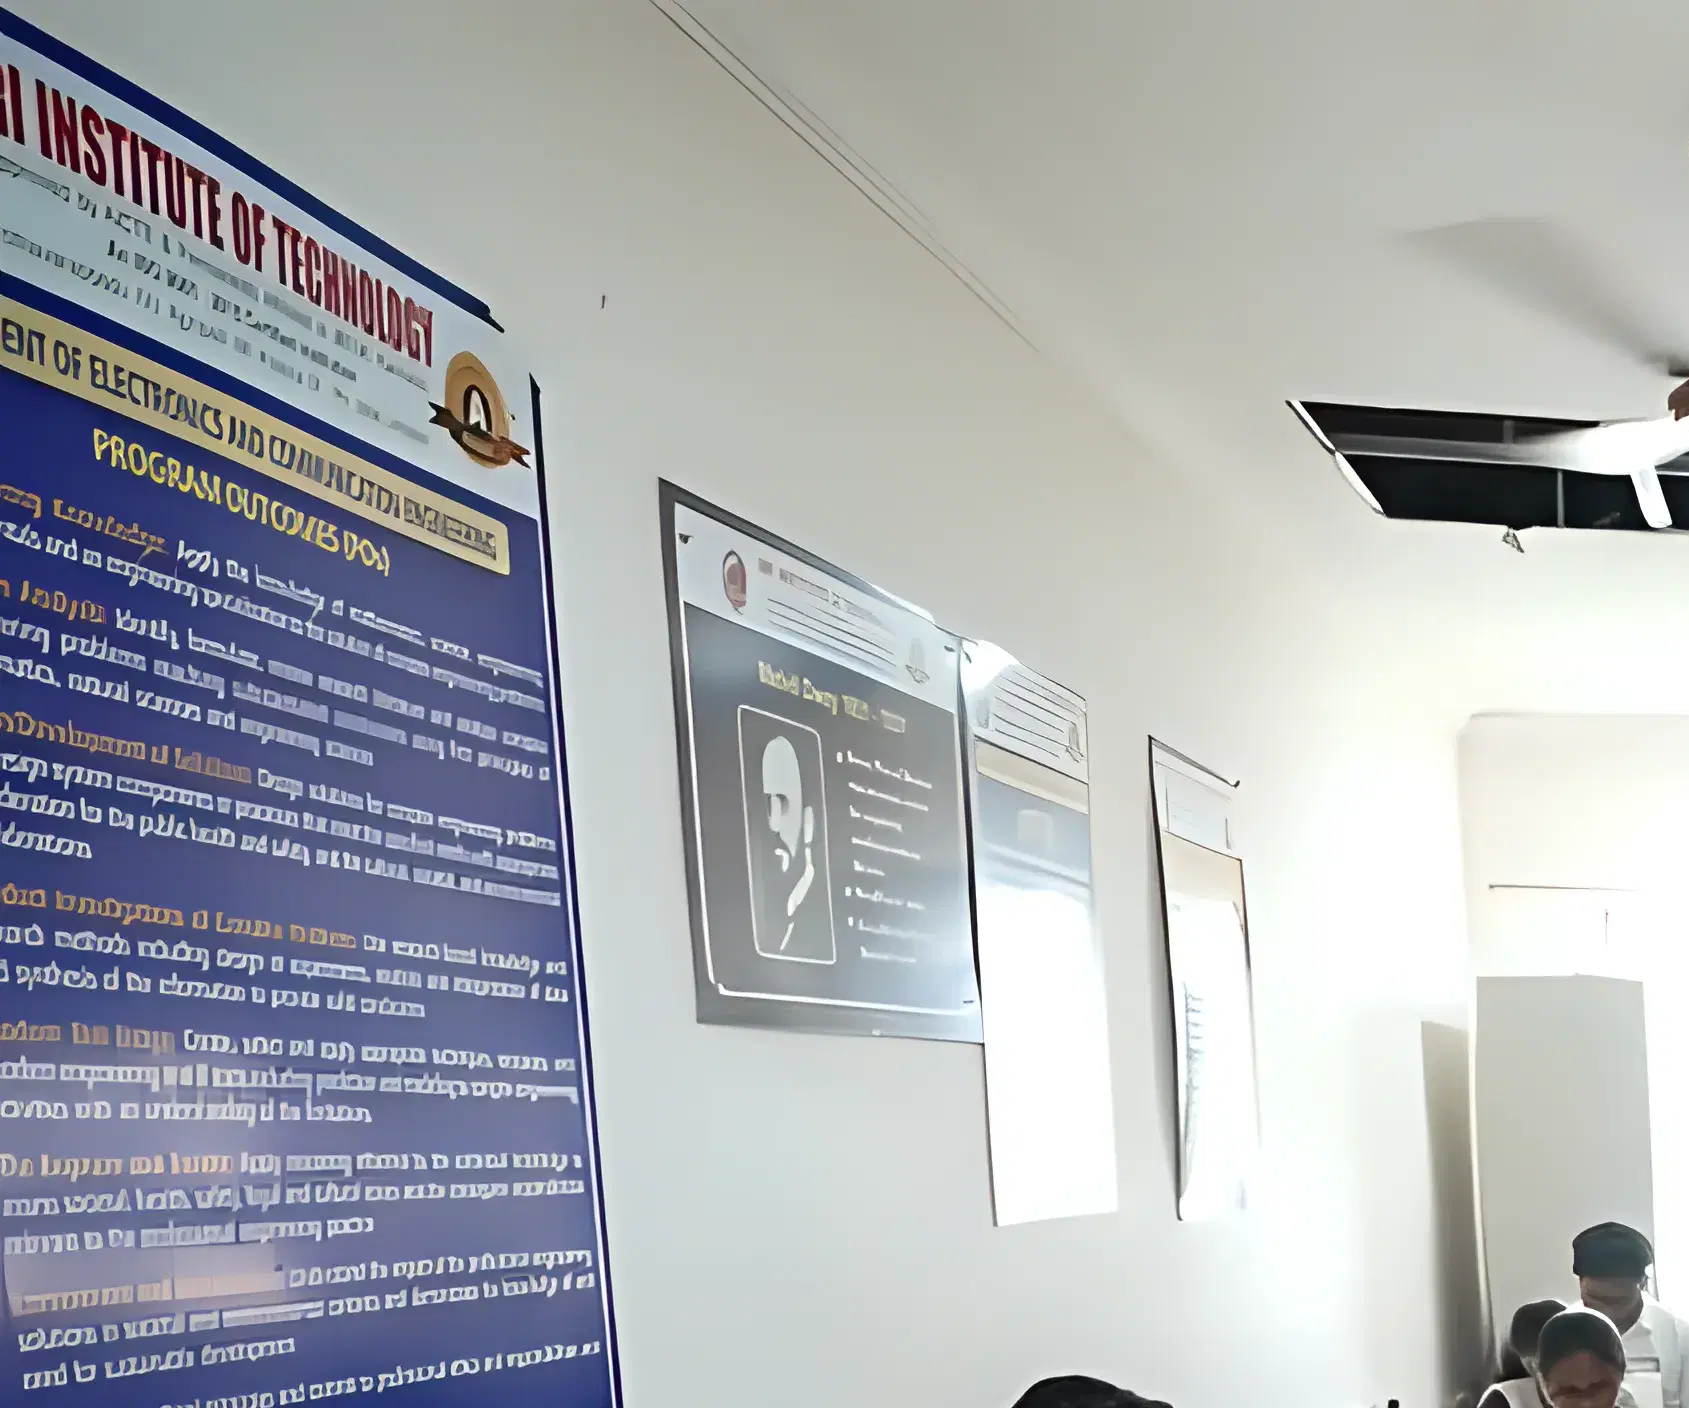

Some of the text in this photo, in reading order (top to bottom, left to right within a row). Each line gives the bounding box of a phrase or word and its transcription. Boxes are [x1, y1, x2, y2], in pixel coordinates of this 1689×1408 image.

[35, 78, 224, 252] INSTITUTE
[231, 191, 265, 273] OF
[272, 214, 433, 368] TECHNOLOGY
[53, 339, 82, 380] OF
[93, 427, 221, 504] PROGRAM
